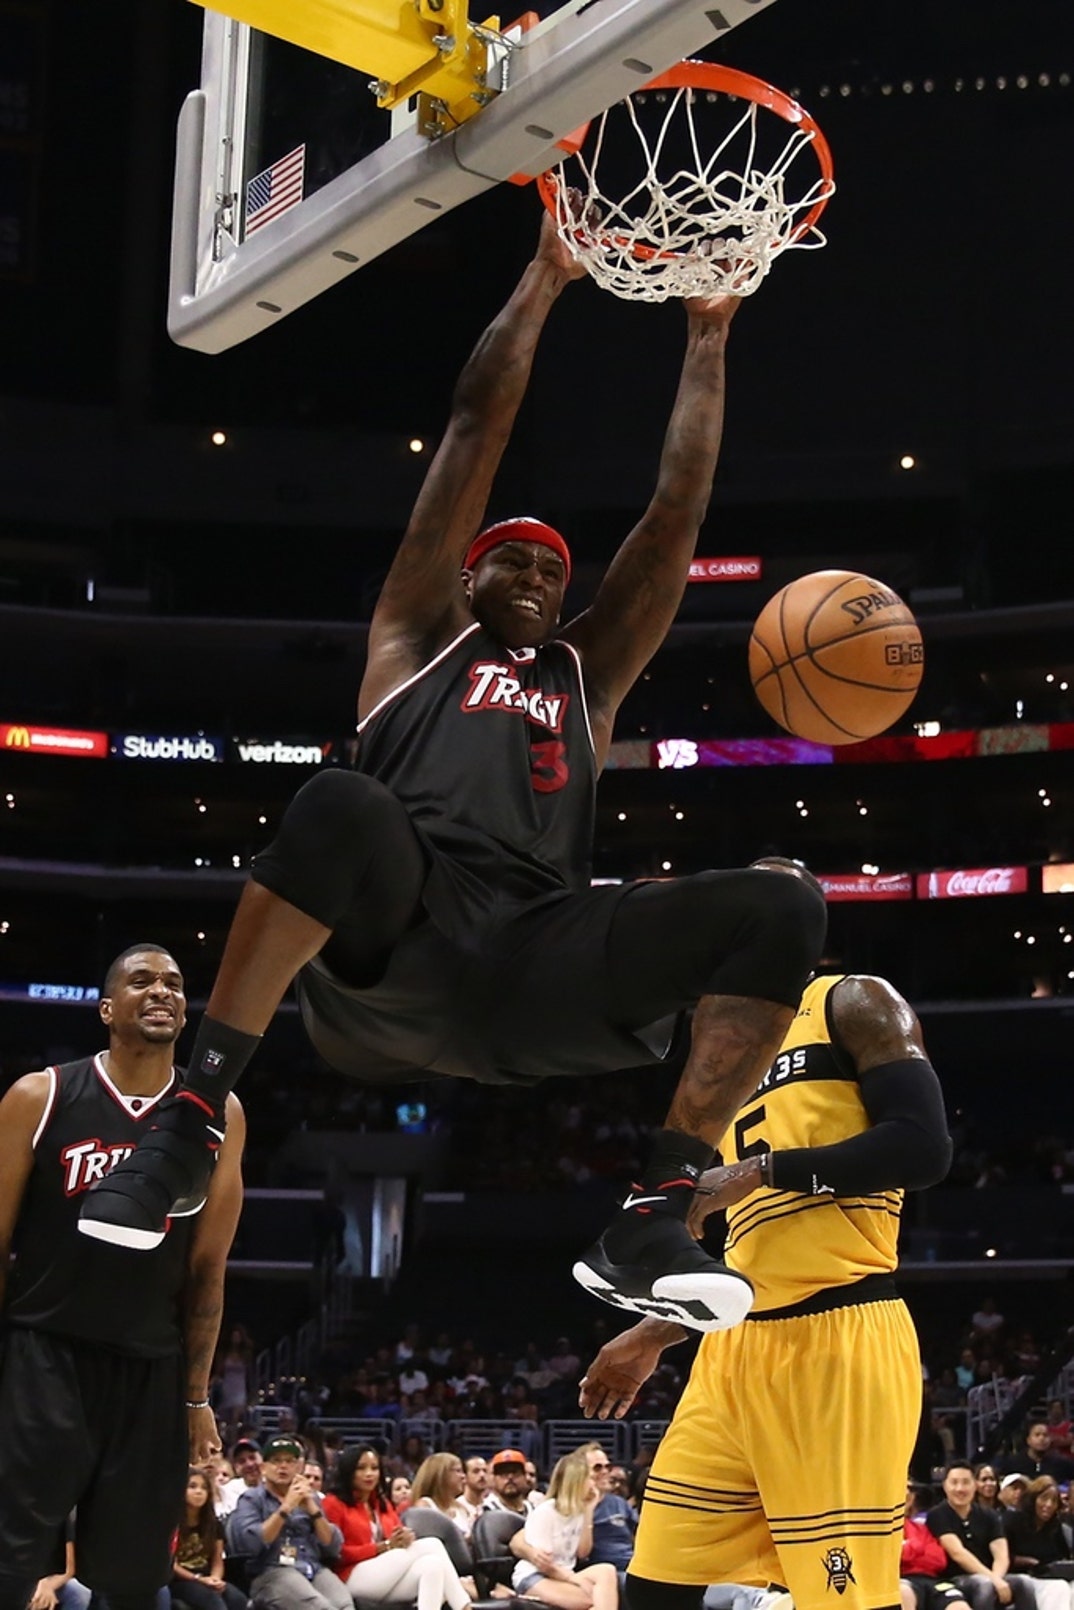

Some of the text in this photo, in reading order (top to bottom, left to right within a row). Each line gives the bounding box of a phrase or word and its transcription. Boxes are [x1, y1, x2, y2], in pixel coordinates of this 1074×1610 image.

[708, 563, 759, 576] CASINO
[123, 736, 215, 760] StubHub
[238, 741, 323, 764] verizon
[530, 740, 570, 793] 3
